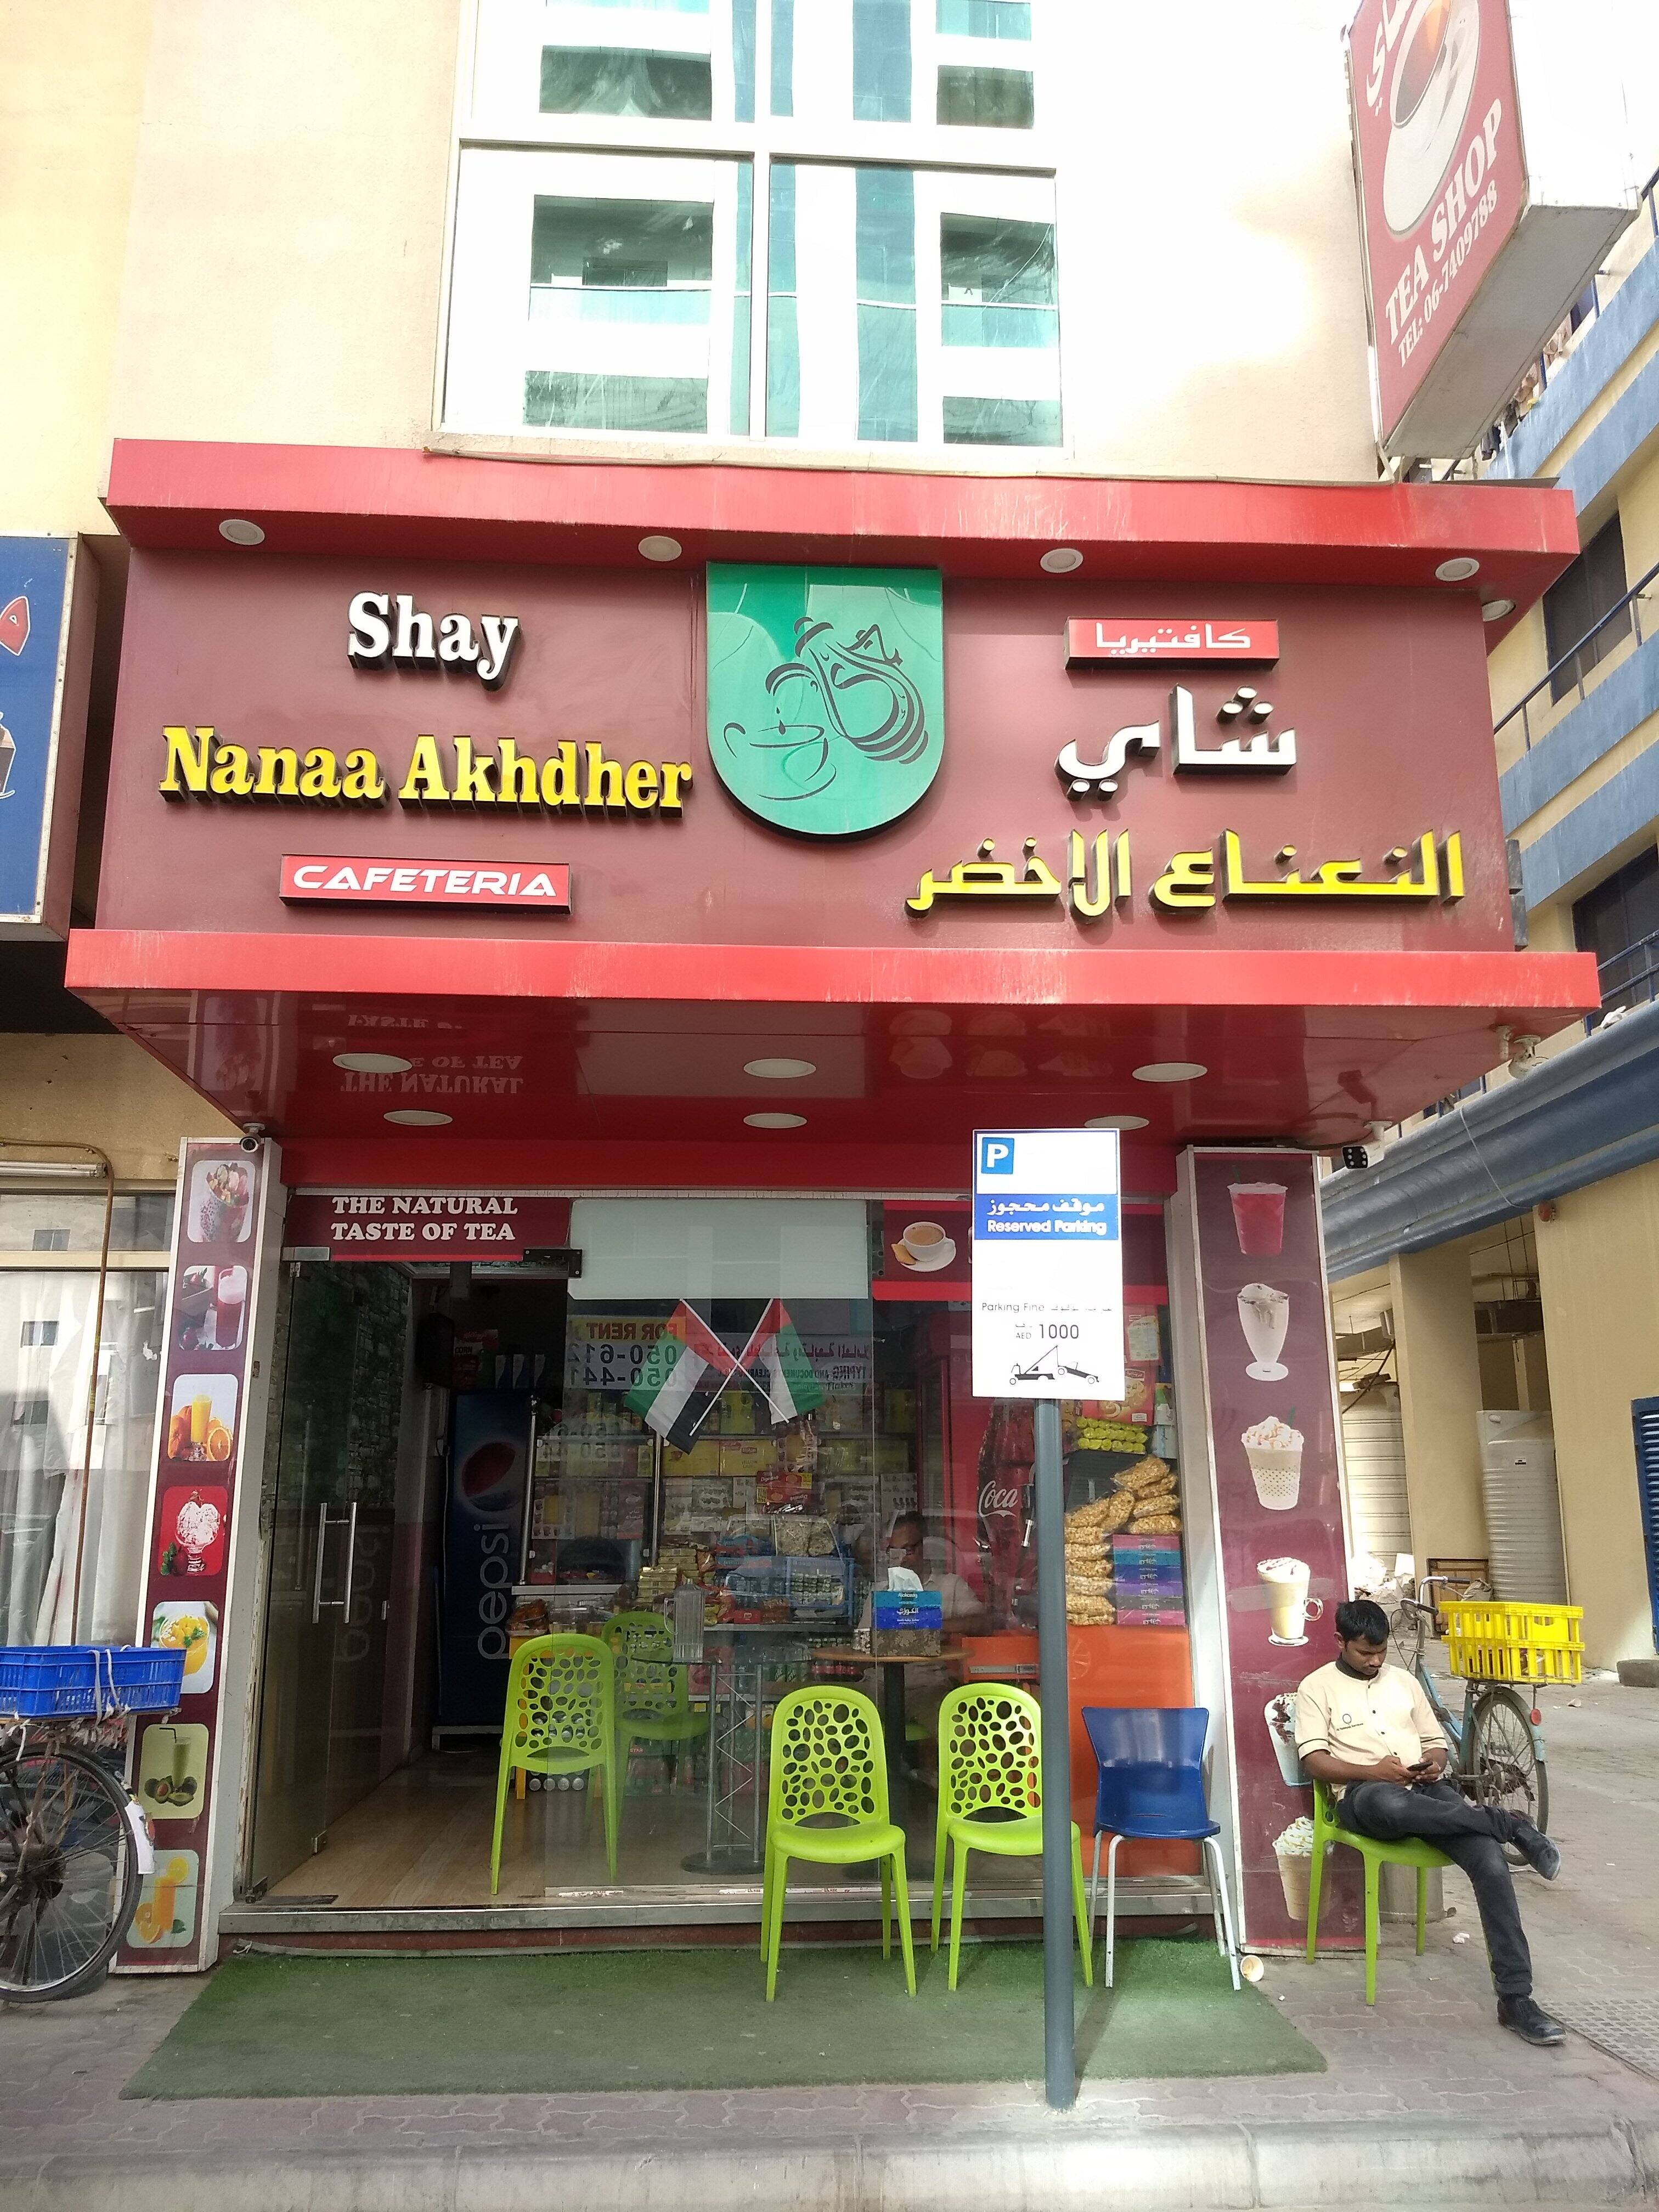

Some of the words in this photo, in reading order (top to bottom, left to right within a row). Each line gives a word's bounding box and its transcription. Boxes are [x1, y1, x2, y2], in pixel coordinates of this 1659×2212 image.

[1385, 245, 1430, 346] TEA
[1432, 98, 1503, 255] SHOP
[1398, 316, 1423, 370] TEL:
[1424, 180, 1498, 325] 06-7409788
[347, 591, 519, 684] Shay
[1095, 622, 1252, 656] كافتيريا
[1057, 685, 1297, 794] شاي
[159, 725, 385, 802] Nanaa
[398, 733, 692, 811] Akhdher
[293, 864, 557, 898] CAFETERIA
[1153, 828, 1465, 908] النعناع
[986, 1143, 1009, 1168] P
[331, 1197, 385, 1215] THE
[391, 1197, 518, 1215] NATURAL
[986, 1199, 1050, 1216] محجوز
[1052, 1198, 1105, 1216] موقف
[330, 1222, 416, 1241] TASTE
[421, 1222, 458, 1241] OF
[464, 1223, 516, 1241] TEA
[987, 1220, 1052, 1233] Reserved
[1054, 1220, 1107, 1236] Parking
[982, 1302, 1019, 1313] Parking
[1023, 1303, 1045, 1311] Fine
[1039, 1324, 1079, 1339] 1000
[979, 1480, 1019, 1516] Coca
[473, 1523, 513, 1660] pepsi
